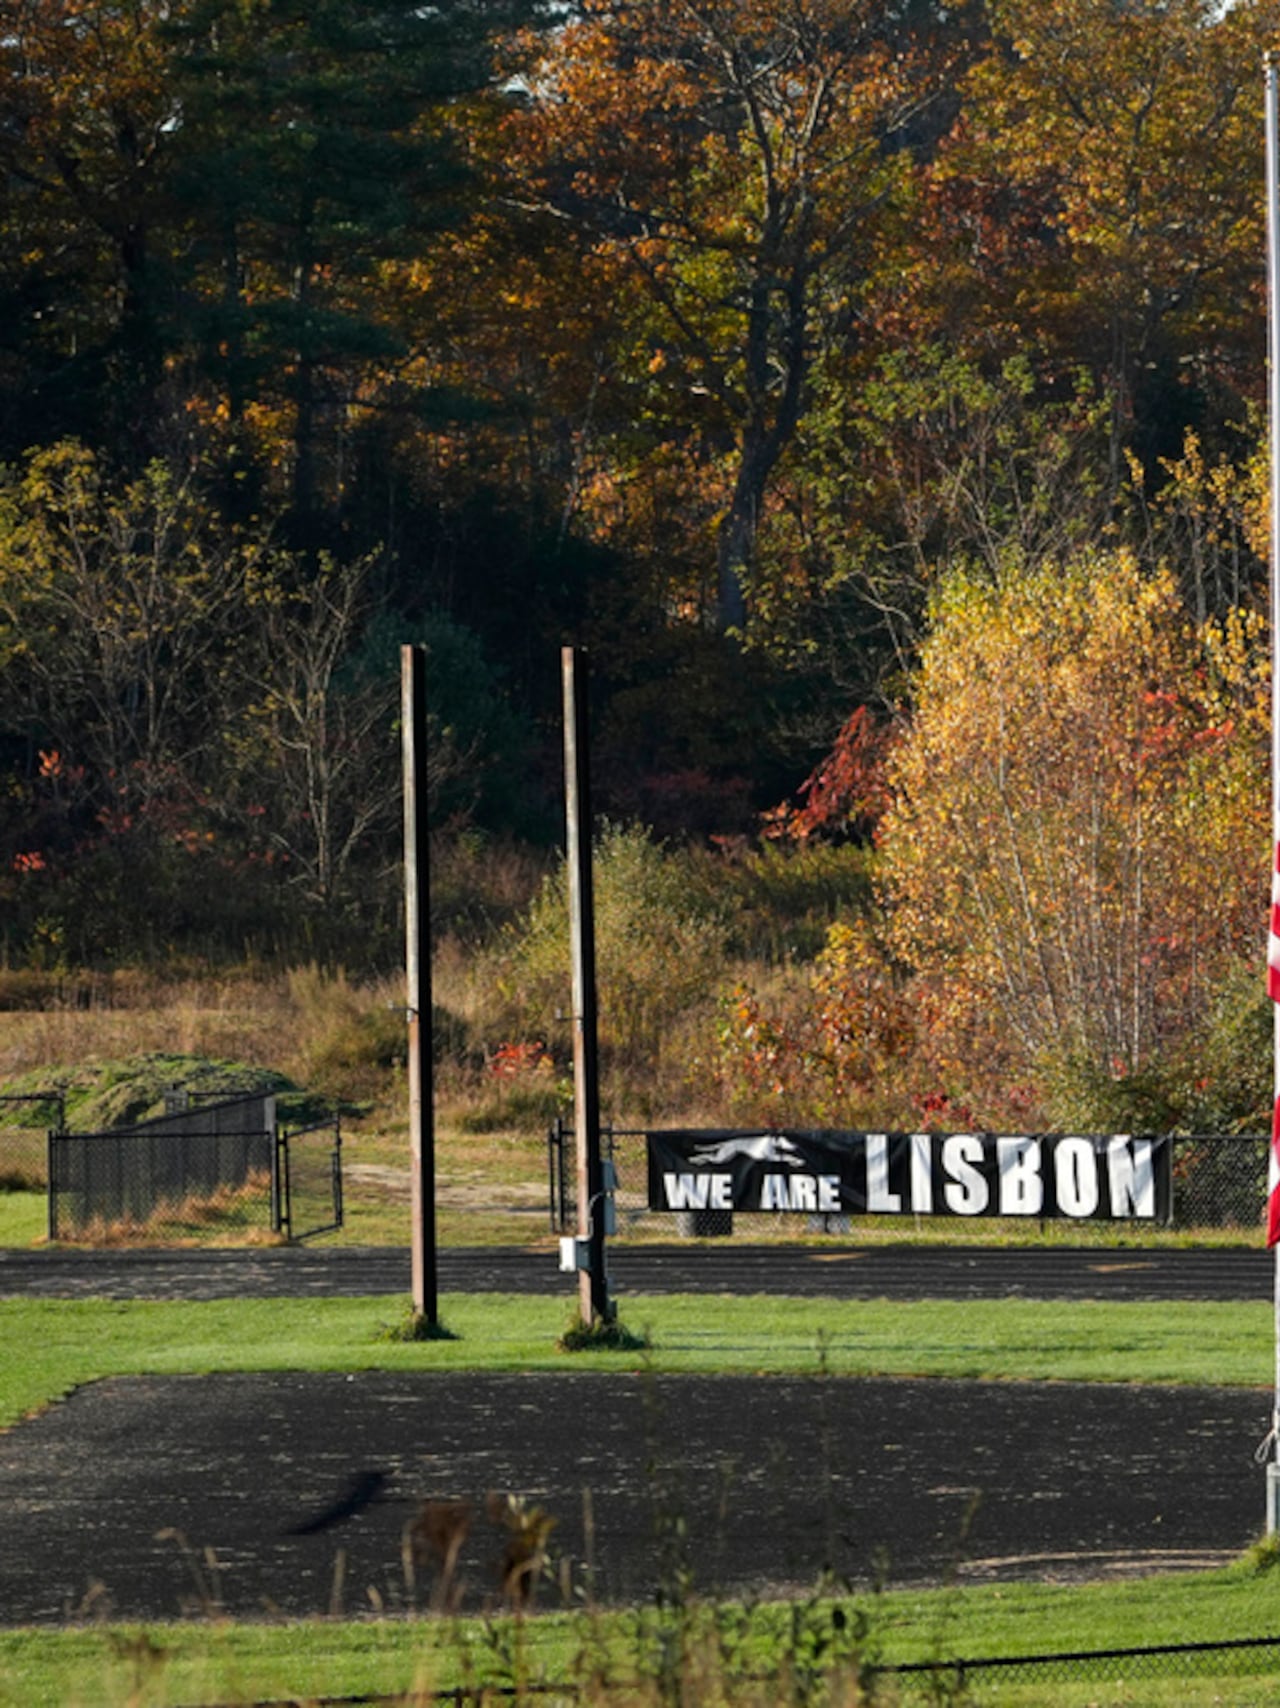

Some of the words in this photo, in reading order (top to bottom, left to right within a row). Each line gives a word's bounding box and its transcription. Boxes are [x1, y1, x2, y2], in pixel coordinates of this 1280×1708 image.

[663, 1174, 734, 1210] WE
[761, 1174, 842, 1211] ARE
[865, 1134, 1156, 1217] LISBON
